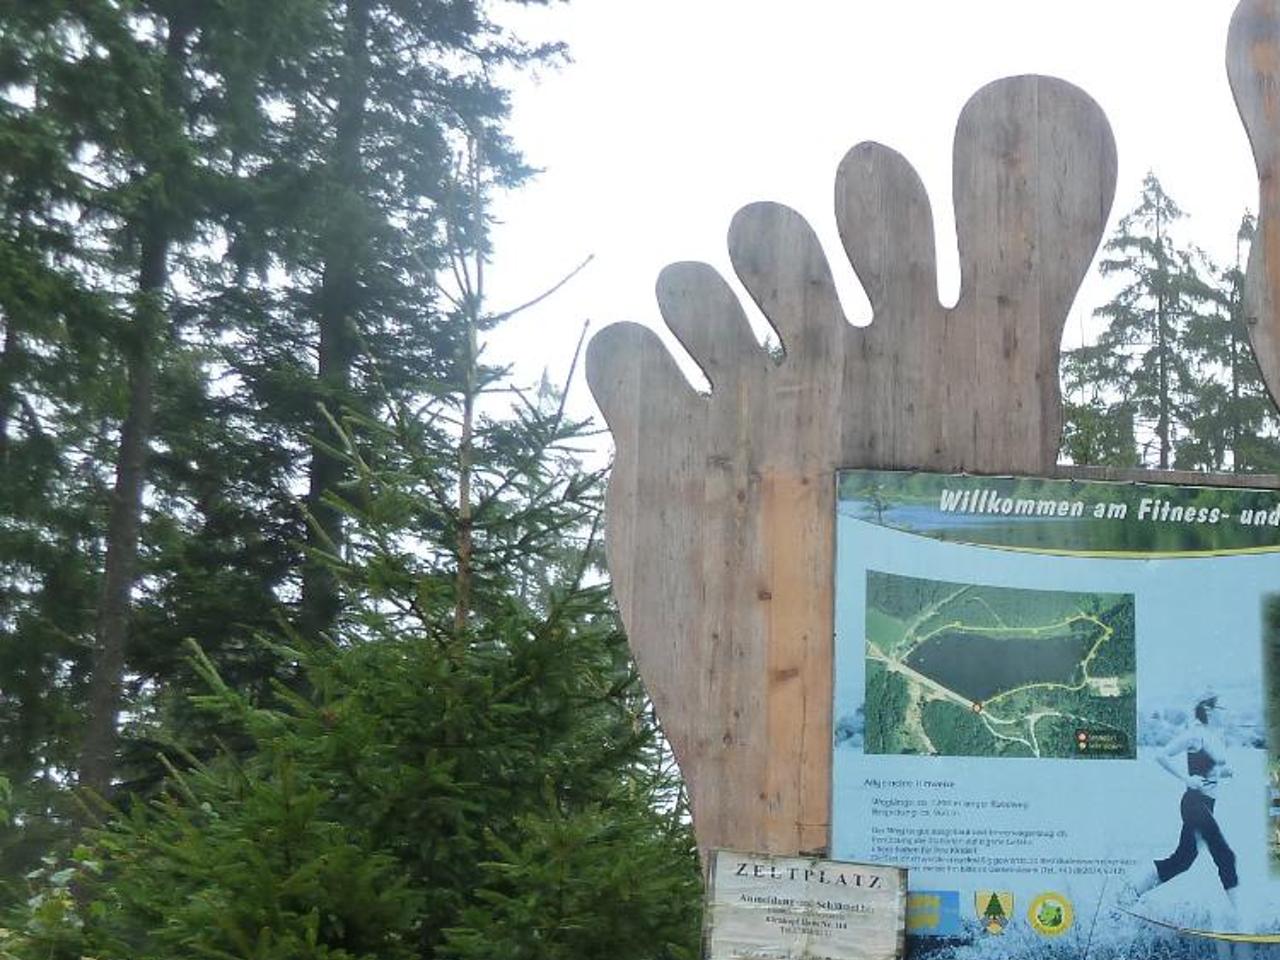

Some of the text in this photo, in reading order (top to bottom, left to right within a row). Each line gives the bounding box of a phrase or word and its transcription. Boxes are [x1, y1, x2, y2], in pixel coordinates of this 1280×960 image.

[939, 488, 1084, 517] Willkommen
[1093, 501, 1128, 519] am
[1137, 498, 1230, 524] Fitness-
[735, 862, 882, 889] ZELTPLATZ
